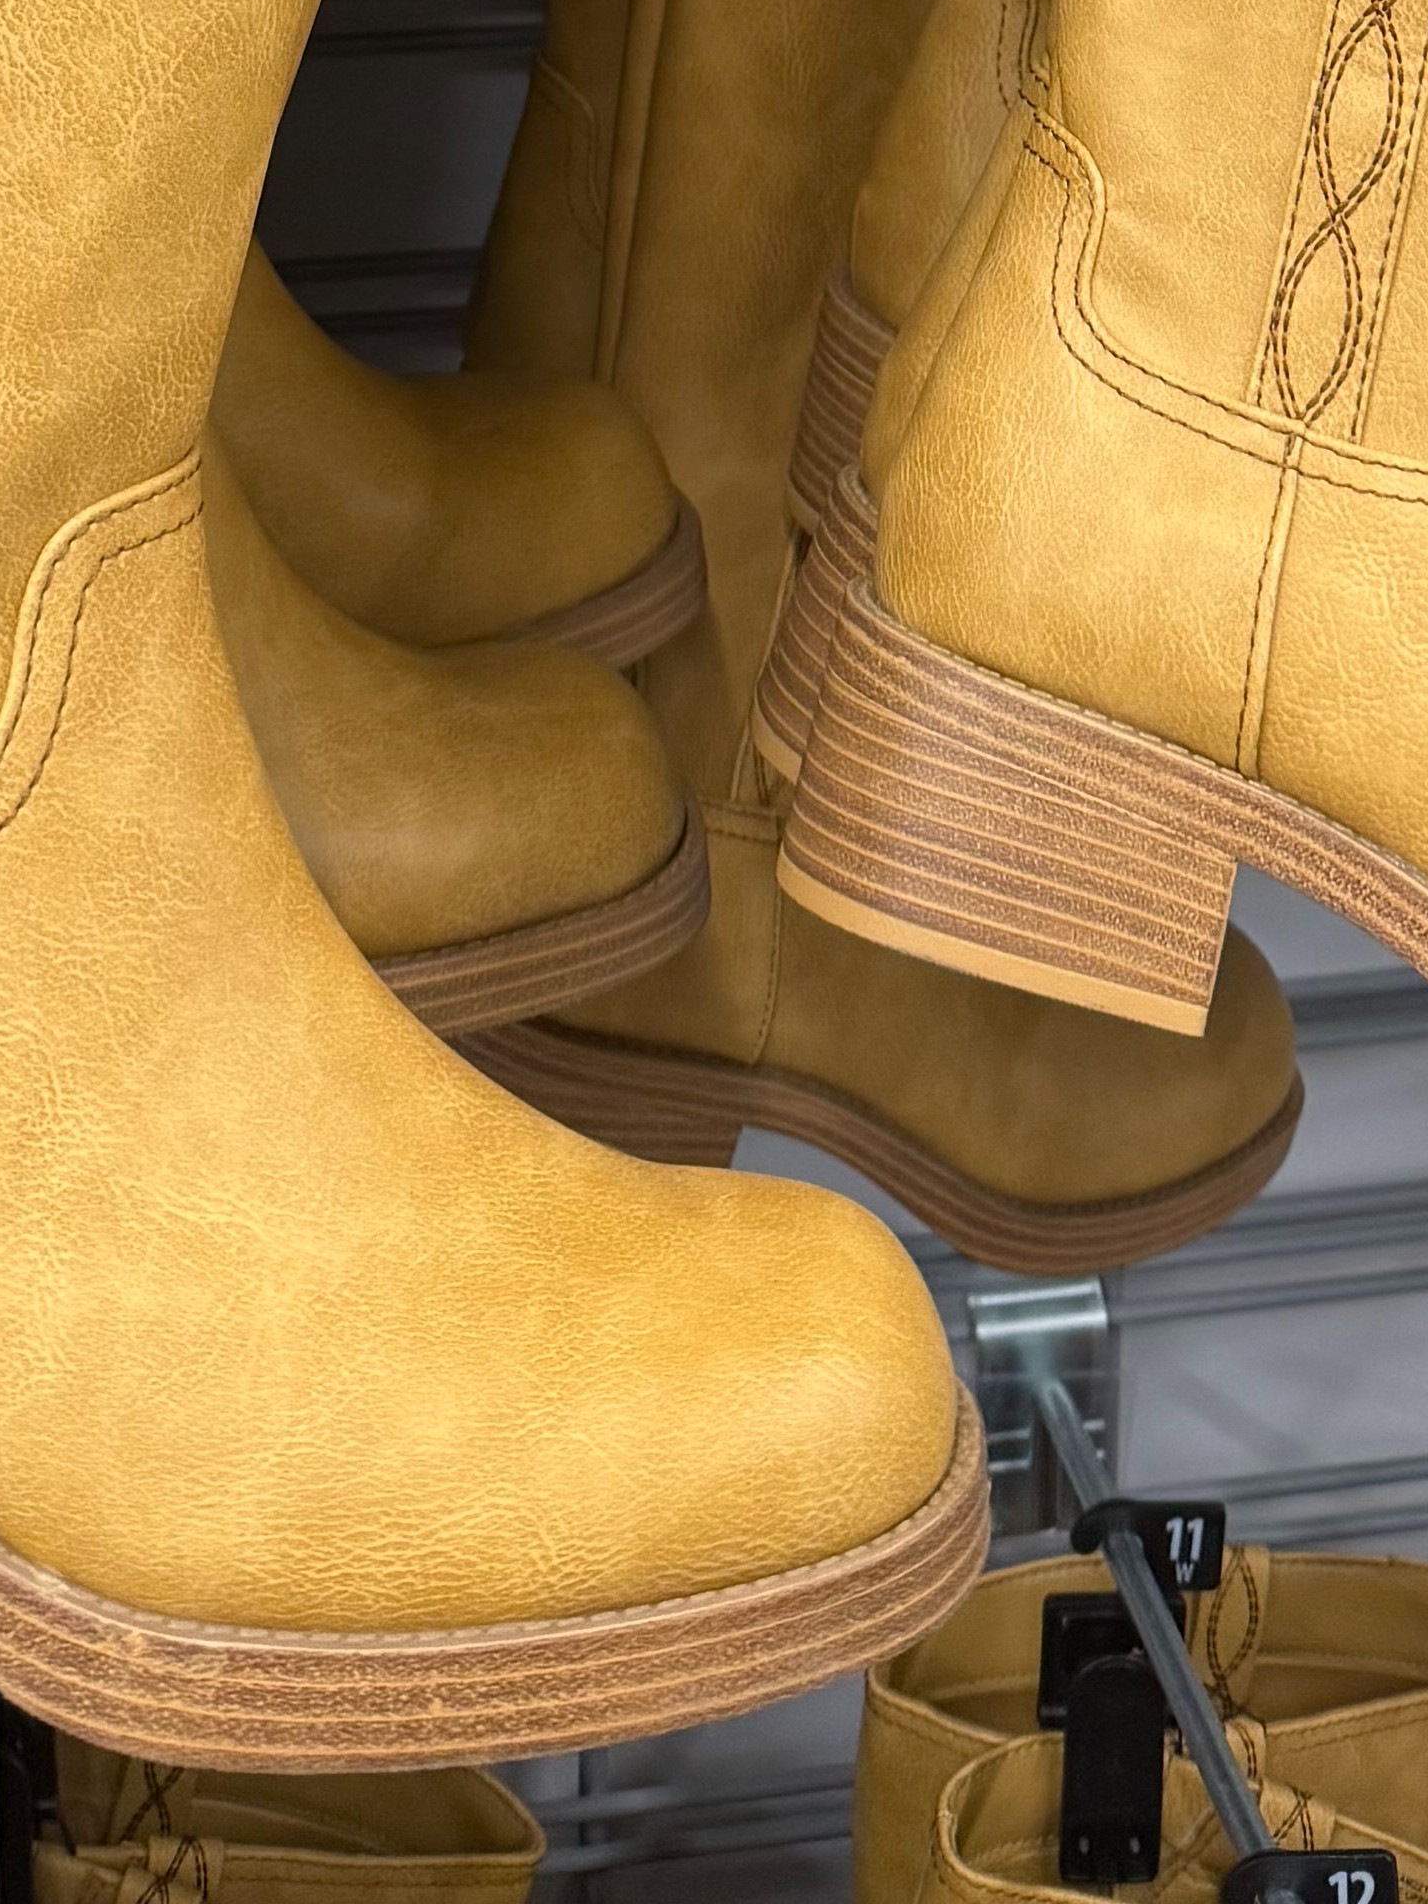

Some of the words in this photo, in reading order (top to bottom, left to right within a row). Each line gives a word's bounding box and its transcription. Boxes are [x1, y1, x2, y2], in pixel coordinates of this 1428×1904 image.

[1165, 1517, 1204, 1562] 11
[1175, 1562, 1198, 1583] W
[1327, 1870, 1376, 1904] 12
